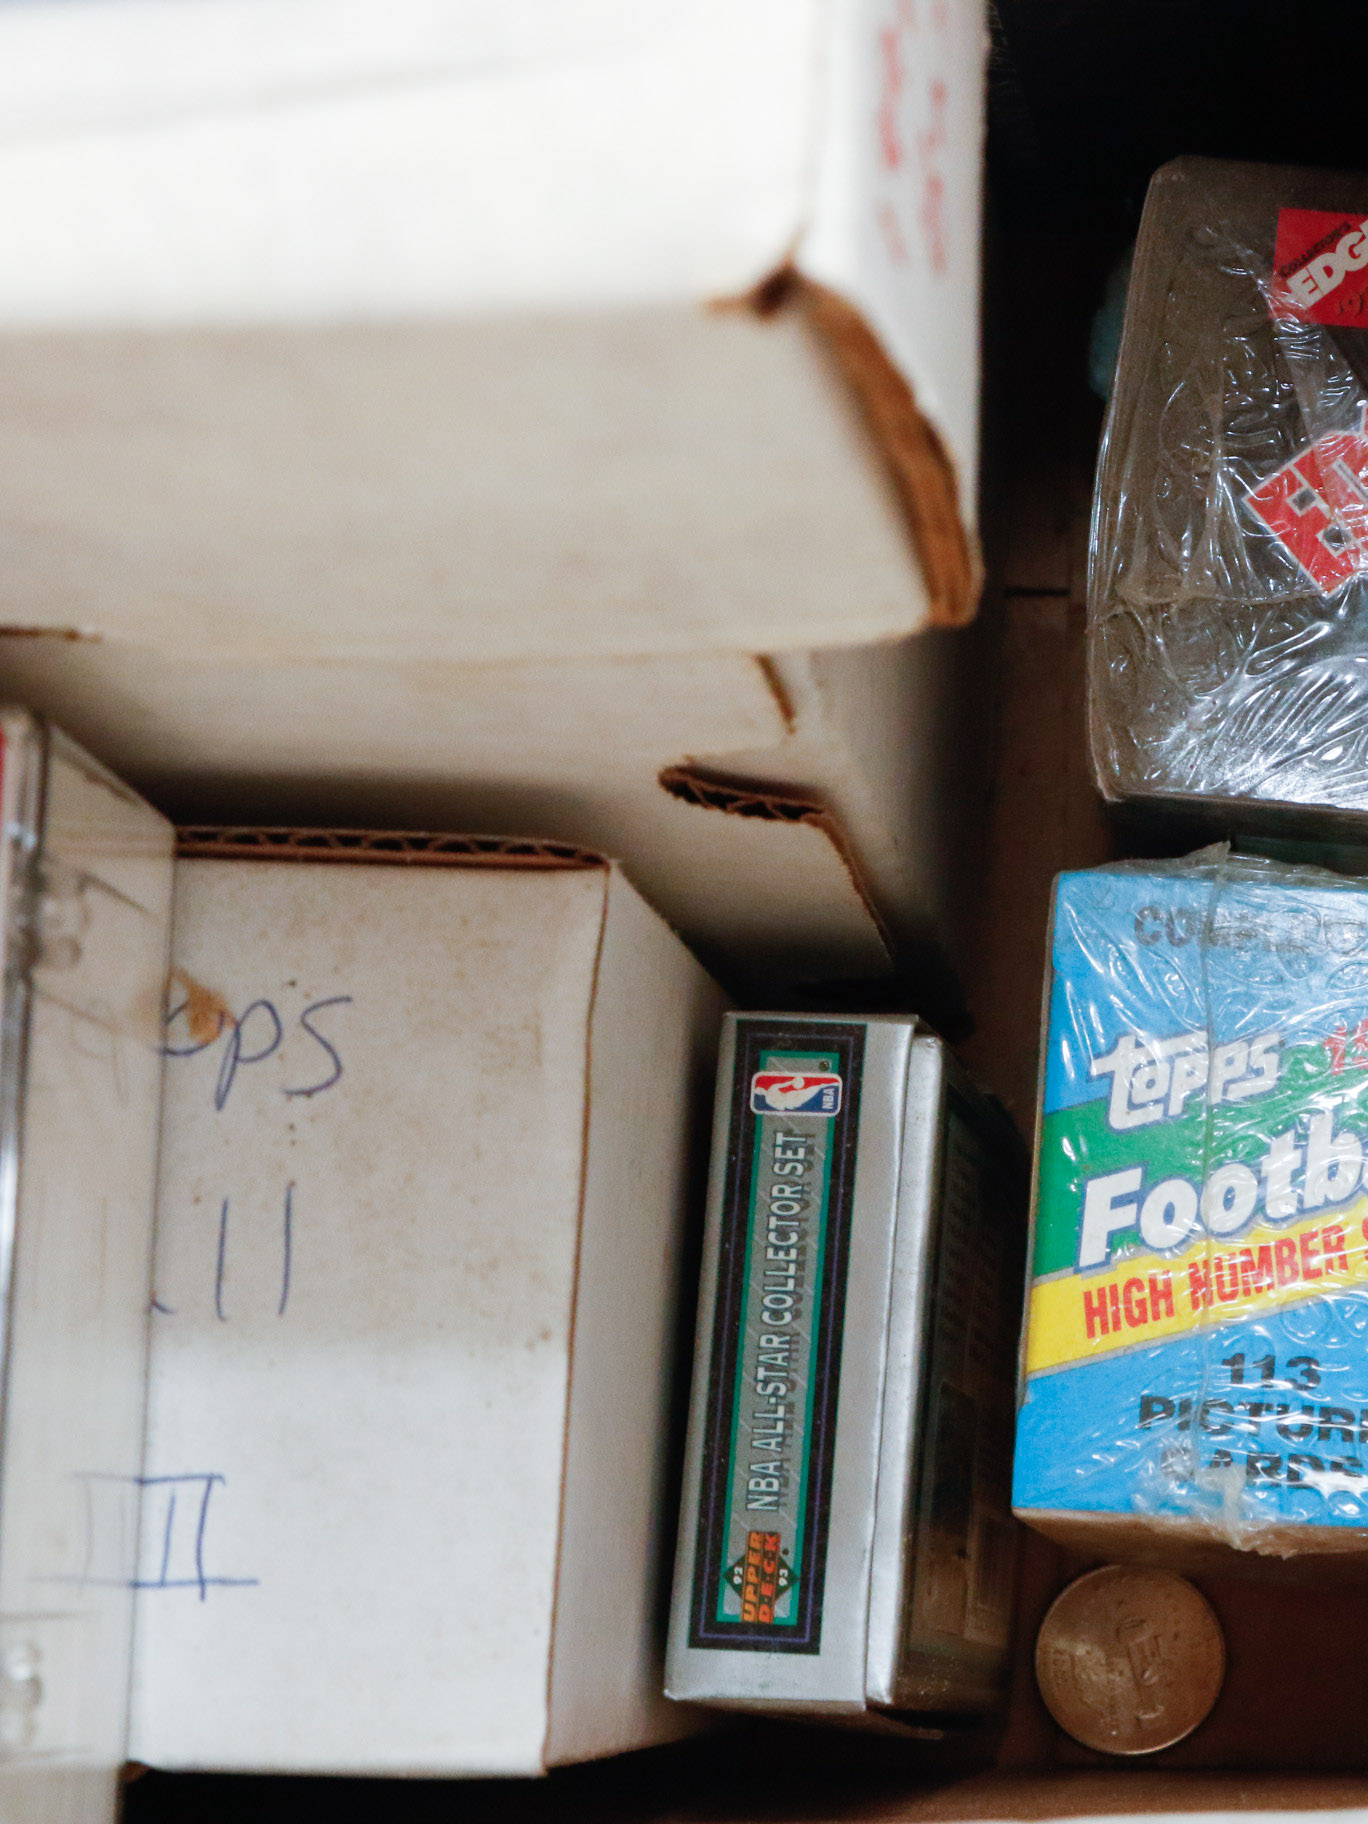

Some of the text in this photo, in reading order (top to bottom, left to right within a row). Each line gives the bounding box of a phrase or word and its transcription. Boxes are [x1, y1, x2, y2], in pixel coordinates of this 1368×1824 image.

[822, 1087, 835, 1110] NBA
[1083, 1271, 1175, 1339] HIGH
[1188, 1225, 1349, 1311] NUMBER
[746, 1132, 807, 1513] NBA ALL-STAR COLLECTOR SET
[1221, 1352, 1322, 1391] 113
[733, 1566, 743, 1585] 92
[743, 1531, 764, 1622] UPPER
[778, 1568, 788, 1587] 93
